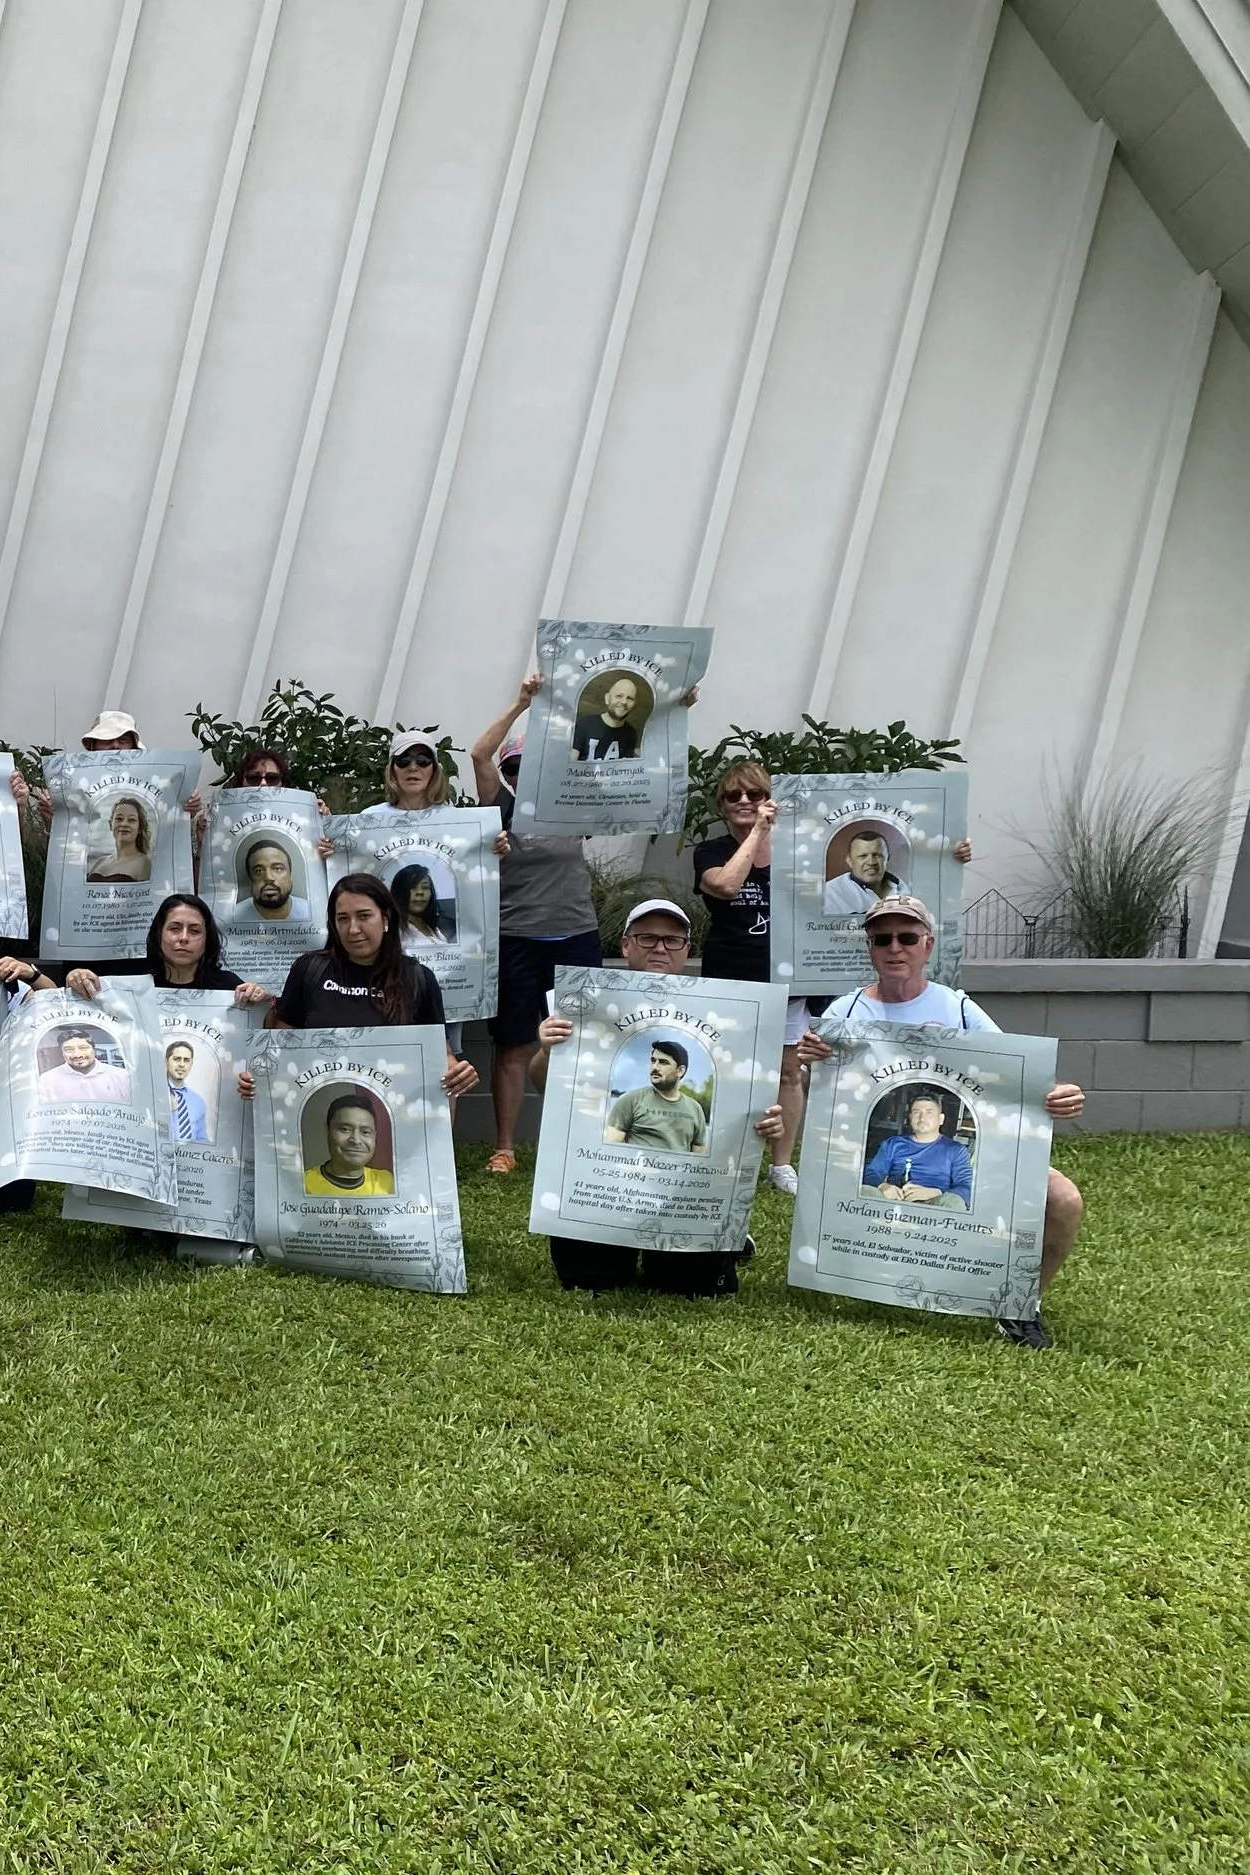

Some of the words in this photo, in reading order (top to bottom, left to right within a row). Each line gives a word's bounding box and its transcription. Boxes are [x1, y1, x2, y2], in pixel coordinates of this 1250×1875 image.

[580, 653, 625, 673] KILLED
[629, 653, 644, 664] BY
[645, 660, 663, 677] ICE
[86, 776, 125, 799] KILLED
[128, 776, 142, 787] BY
[144, 782, 163, 799] ICE
[229, 814, 267, 837] KILLED
[270, 814, 284, 823] BY
[286, 818, 303, 833] ICE
[823, 802, 870, 826] KILLED
[874, 802, 890, 813] BY
[893, 809, 916, 825] ICE
[374, 838, 414, 862] KILLED
[418, 838, 432, 848] BY
[435, 842, 456, 858] ICE
[806, 919, 846, 931] Randall
[324, 980, 368, 996] Common
[30, 1010, 74, 1030] KILLED
[98, 1011, 119, 1024] ICE
[184, 1020, 200, 1029] BY
[202, 1024, 224, 1043] ICE
[614, 1008, 669, 1032] KILLED
[673, 1010, 693, 1023] BY
[694, 1019, 722, 1043] ICE
[294, 1062, 343, 1088] KILLED
[347, 1062, 365, 1073] BY
[367, 1068, 393, 1088] ICE
[870, 1060, 929, 1083] KILLED
[934, 1063, 954, 1077] BY
[955, 1072, 985, 1096] ICE
[27, 1108, 68, 1119] Lorenzo
[70, 1104, 112, 1120] Salgado
[113, 1108, 146, 1127] Araujo
[577, 1148, 640, 1166] Mohammad
[642, 1156, 680, 1171] Nazeer
[280, 1201, 298, 1215] Jose
[300, 1201, 351, 1220] Guadalupe
[353, 1201, 429, 1216] Ramos-Solano
[836, 1202, 880, 1218] Norlan
[884, 1208, 994, 1236] Guzman-Fuentes
[866, 1224, 892, 1235] 1988
[904, 1231, 958, 1247] 9.24.2025
[832, 1236, 851, 1246] years
[852, 1238, 867, 1248] old,
[878, 1243, 912, 1256] Salvador,
[914, 1250, 938, 1259] victim
[940, 1254, 949, 1262] of
[949, 1255, 972, 1264] active
[974, 1258, 1004, 1269] shooter
[832, 1244, 852, 1254] while
[862, 1250, 889, 1262] custody
[900, 1256, 918, 1265] ERO
[920, 1260, 945, 1270] Dallas
[946, 1264, 966, 1272] Field
[968, 1266, 992, 1276] Office
